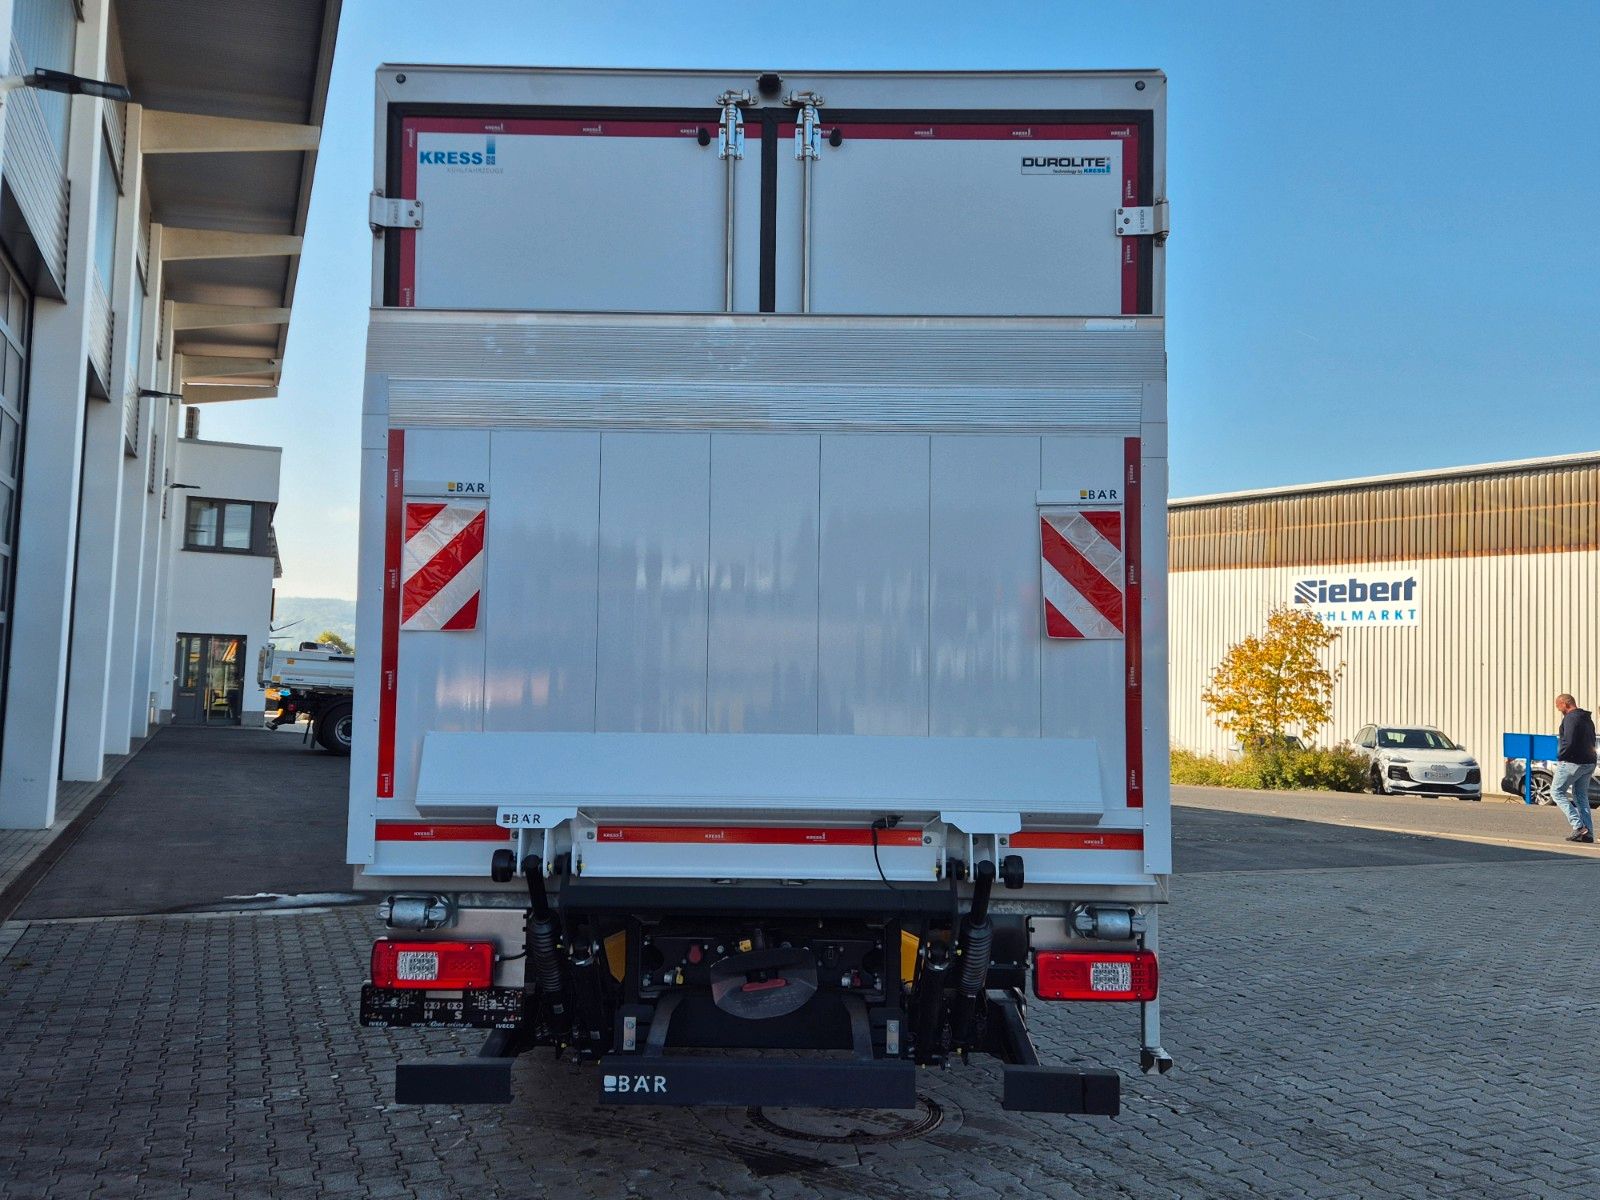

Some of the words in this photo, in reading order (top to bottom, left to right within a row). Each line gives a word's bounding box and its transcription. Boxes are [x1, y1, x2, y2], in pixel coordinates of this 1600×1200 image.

[420, 151, 483, 165] KRESS
[1022, 157, 1106, 167] DUROLITE
[456, 482, 485, 493] BÄR
[1088, 489, 1117, 500] BÄR
[1294, 576, 1417, 604] Siebert
[511, 814, 541, 824] BÄR
[618, 1075, 667, 1093] BÄR
